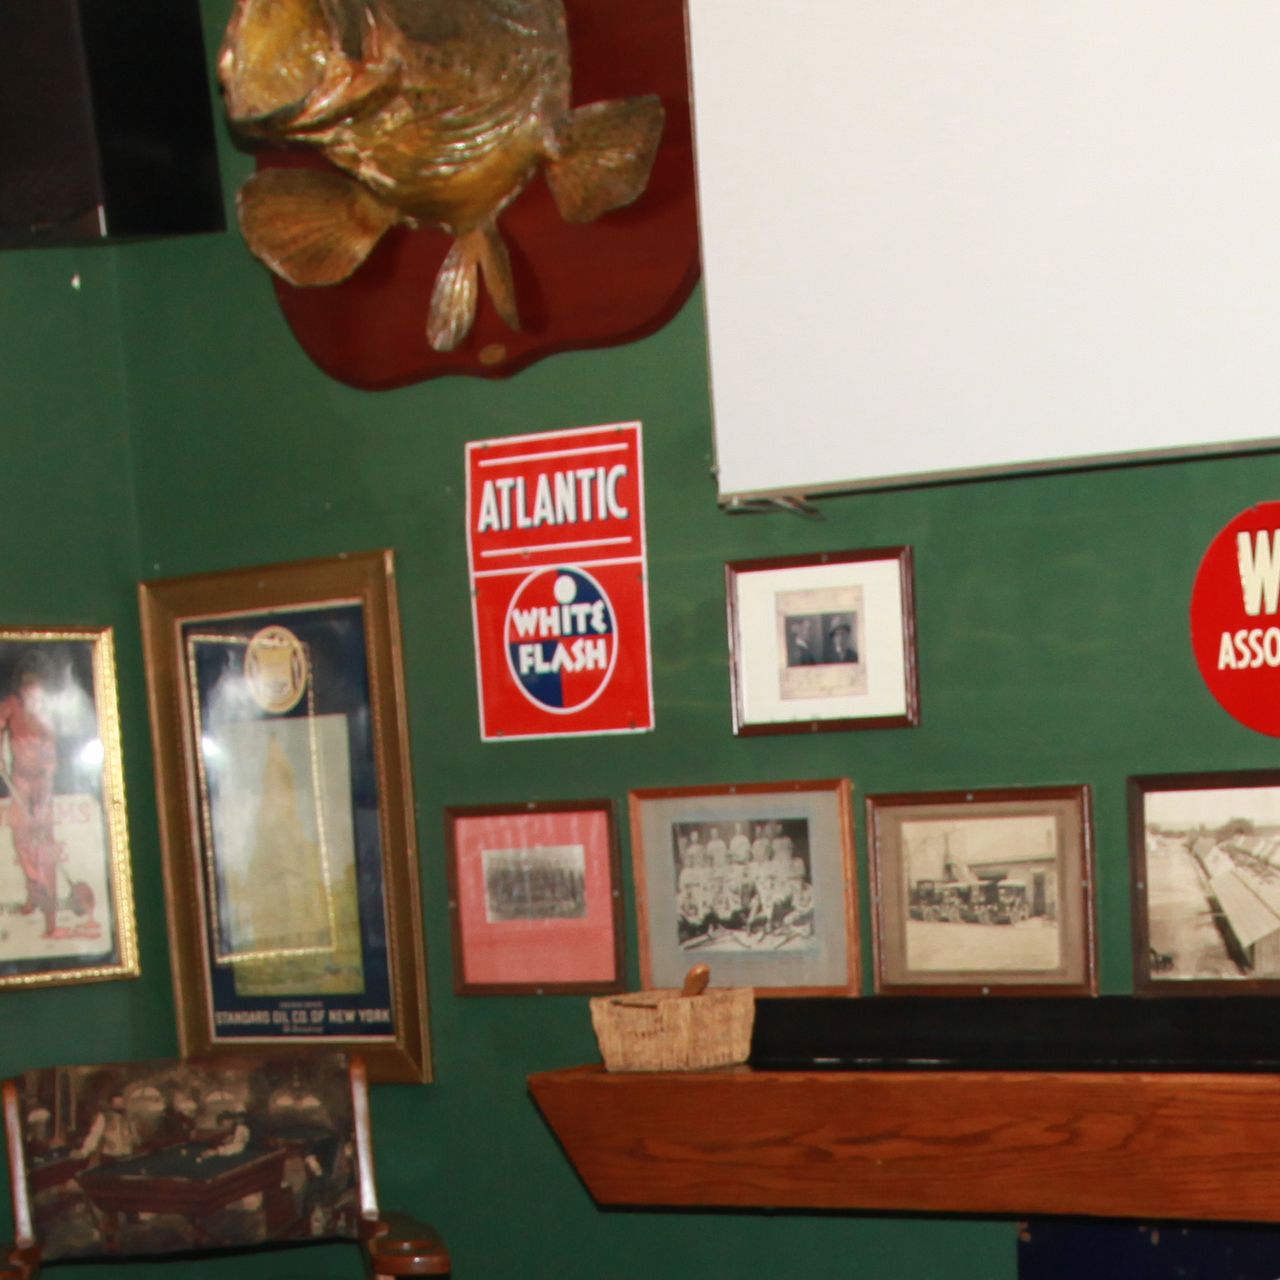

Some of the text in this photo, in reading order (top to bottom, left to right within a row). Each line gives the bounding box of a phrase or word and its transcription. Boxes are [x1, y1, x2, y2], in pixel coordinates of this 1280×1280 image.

[477, 463, 629, 533] ATLANTIC
[510, 577, 609, 638] WHITE
[517, 637, 608, 675] FLASH
[328, 1008, 356, 1024] NEW
[358, 1007, 391, 1024] YORK
